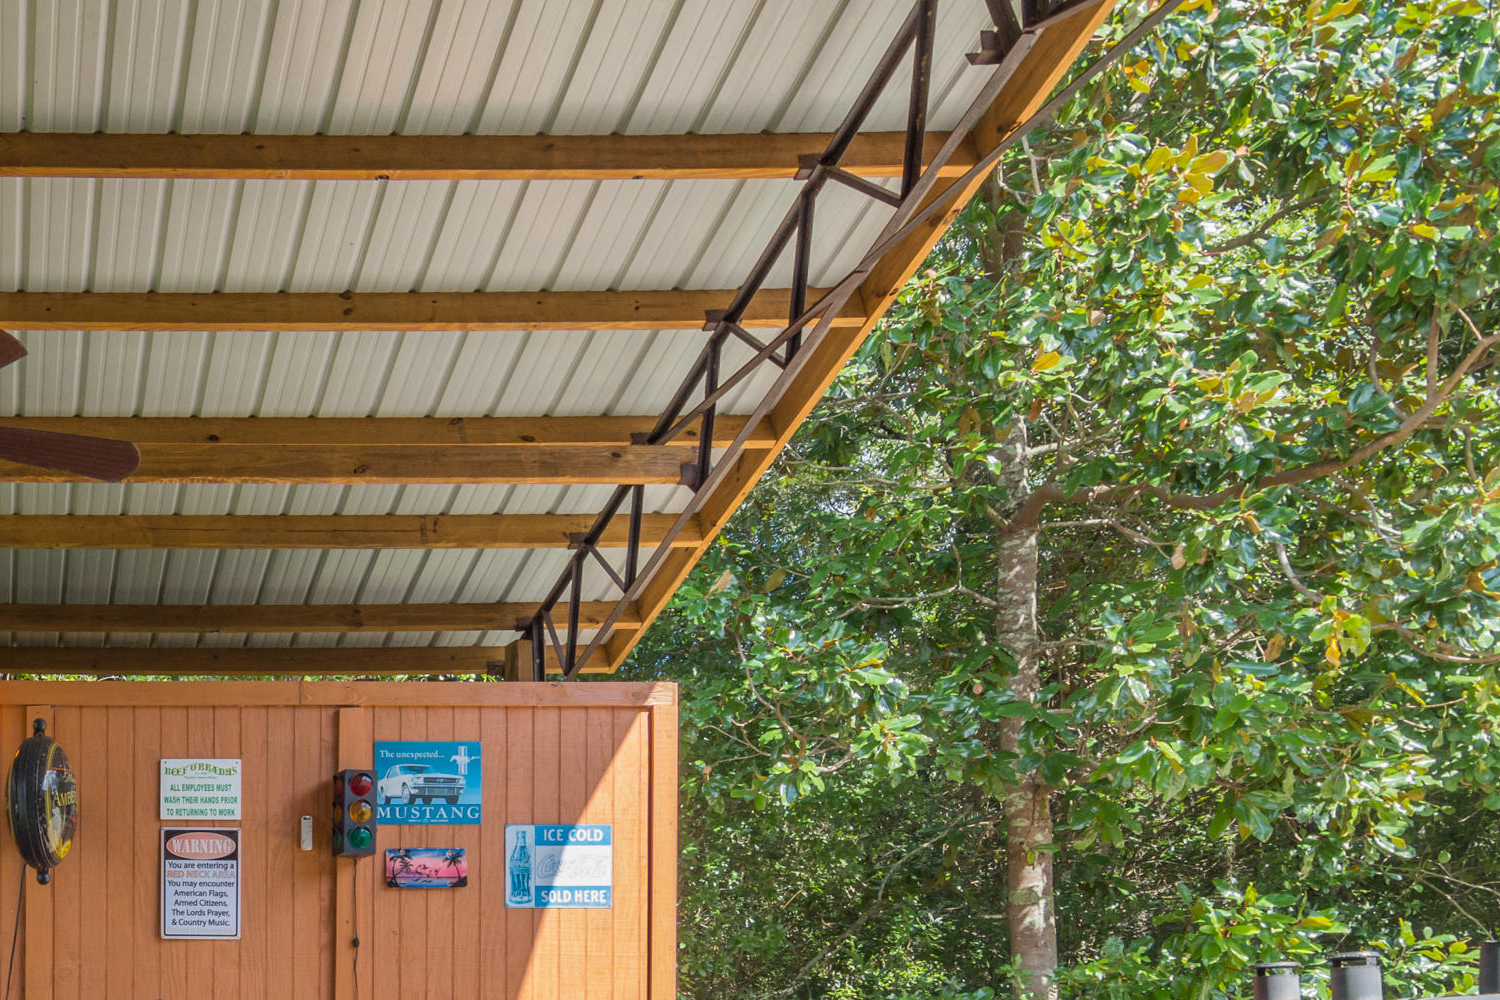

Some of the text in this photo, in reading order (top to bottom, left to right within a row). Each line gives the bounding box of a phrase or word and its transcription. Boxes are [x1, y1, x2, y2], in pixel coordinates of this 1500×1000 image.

[379, 750, 444, 760] The unexpected...
[164, 766, 188, 776] BEEF
[170, 784, 232, 792] ALL EMPLOYEES MUST
[164, 796, 238, 804] WASH THEIR HANDS PRIOR
[166, 808, 236, 816] TO RETURNING TO WORK
[376, 806, 480, 819] MUSTANG
[543, 829, 604, 842] ICE COLD
[171, 838, 232, 854] WARNING
[168, 861, 182, 869] You
[196, 861, 228, 870] entering
[166, 870, 185, 878] RED
[186, 870, 211, 878] NECK
[182, 881, 197, 889] may
[173, 889, 229, 898] American Flags,
[541, 890, 607, 903] SOLD HERE
[173, 899, 229, 907] Armed Citizens,
[207, 909, 231, 918] Prayer,
[178, 919, 207, 927] Country
